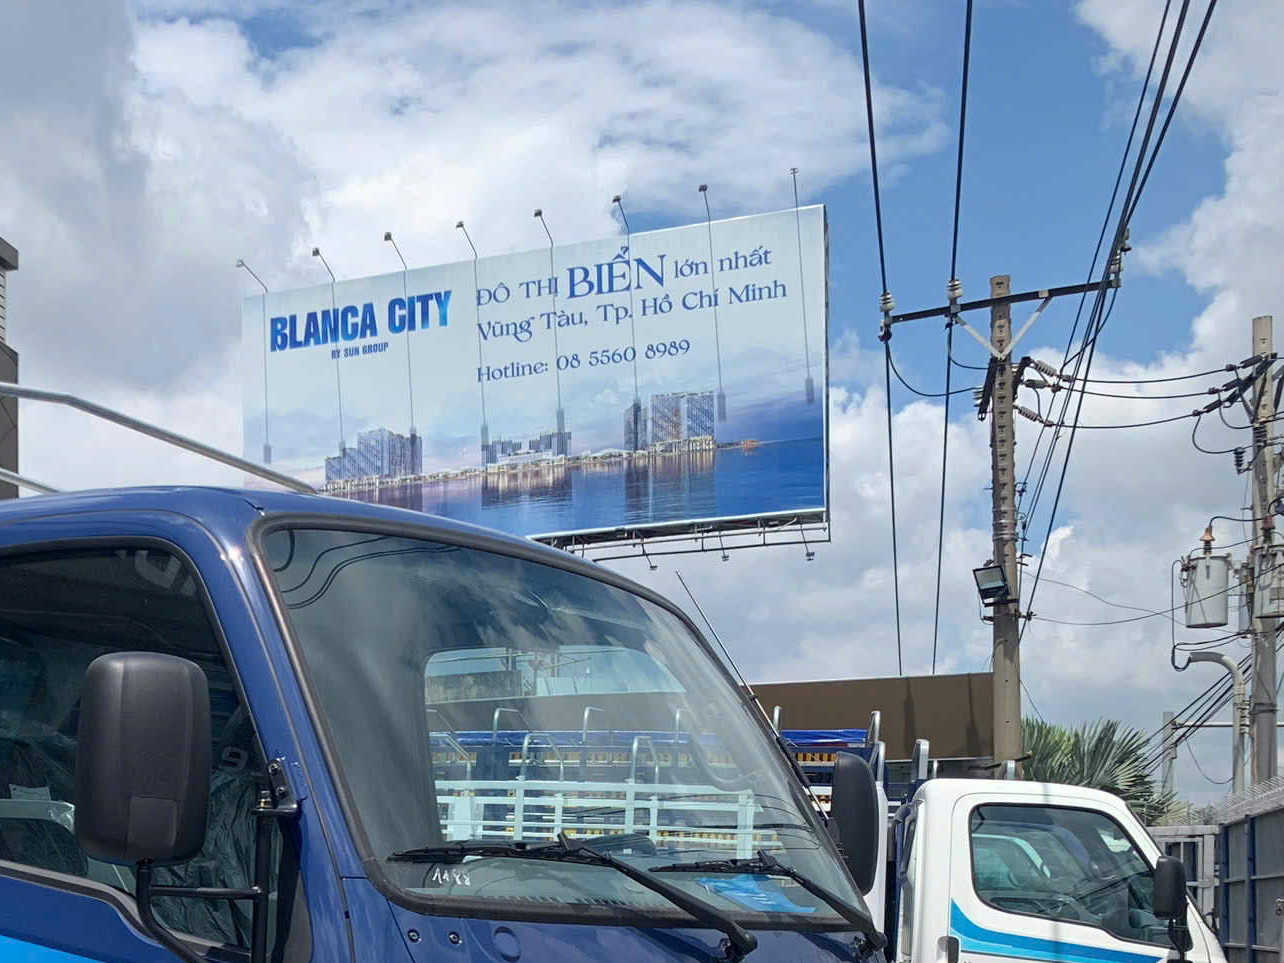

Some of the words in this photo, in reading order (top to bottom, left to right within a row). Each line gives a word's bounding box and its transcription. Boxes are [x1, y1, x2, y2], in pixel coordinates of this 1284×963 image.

[476, 282, 511, 307] ĐÔ
[519, 276, 559, 299] THỊ
[566, 246, 666, 299] BIỂN
[674, 259, 708, 279] lớn
[718, 245, 772, 272] nhất
[270, 302, 378, 352] BLANCA
[387, 290, 452, 334] CITY
[477, 316, 535, 342] Vũng
[539, 310, 588, 330] Tàu,
[596, 303, 633, 325] Tp.
[641, 293, 673, 316] Hồ
[682, 288, 719, 311] Chí
[728, 279, 787, 304] Minh
[331, 350, 341, 359] BY
[344, 346, 360, 358] SUN
[362, 342, 389, 355] GROUP
[477, 361, 548, 382] Hotline:
[556, 353, 581, 371] 08
[588, 346, 636, 367] 5560
[645, 339, 690, 359] 8989
